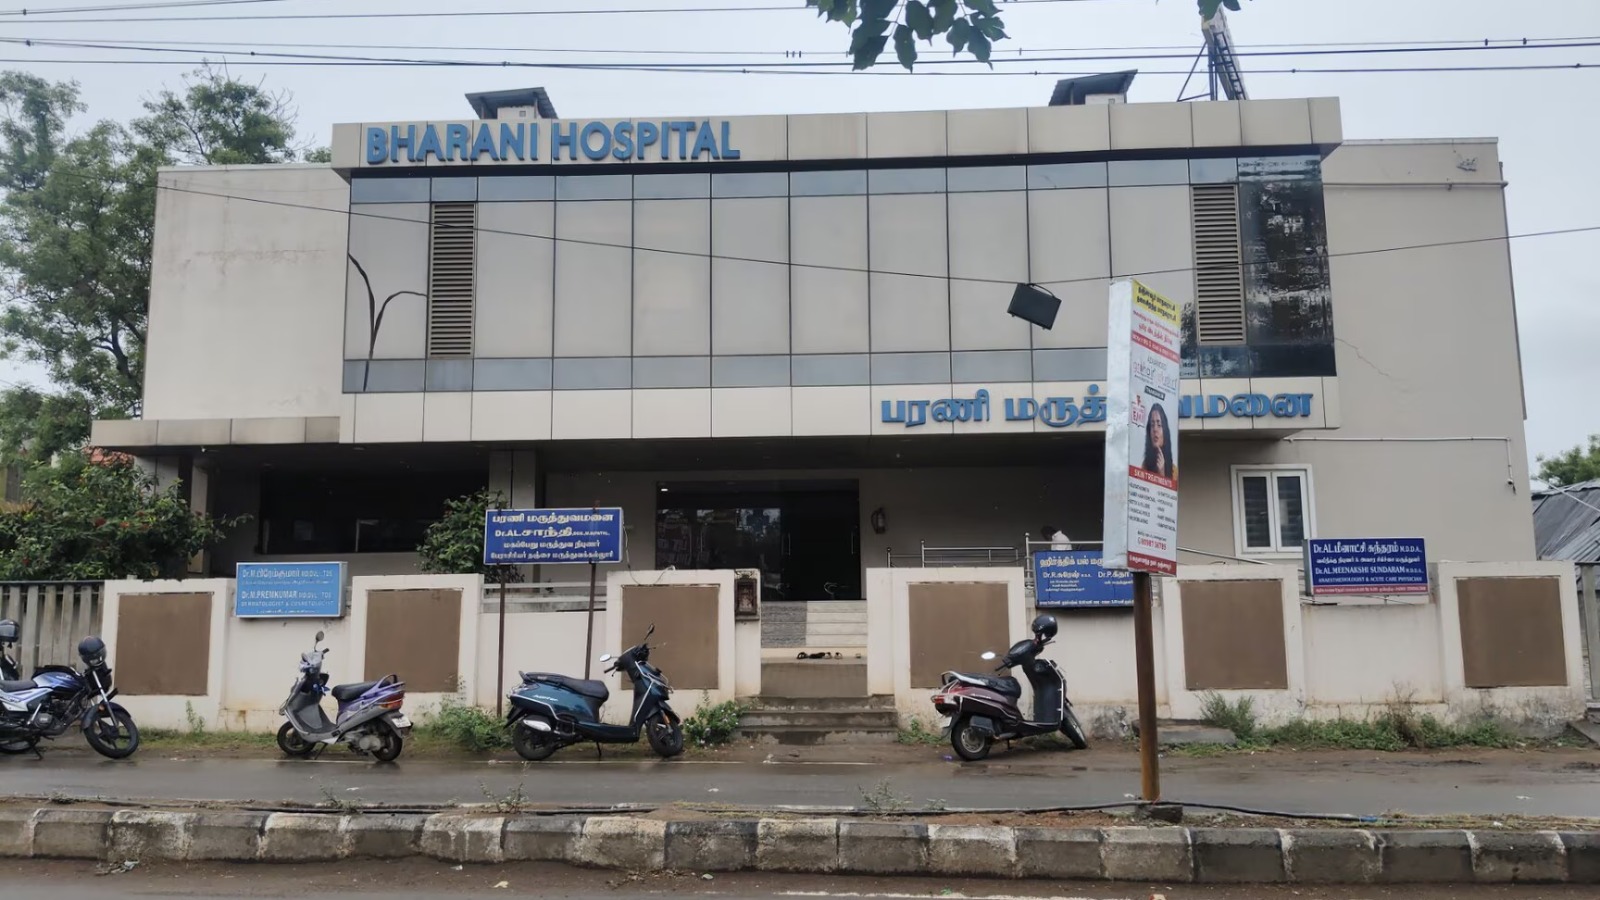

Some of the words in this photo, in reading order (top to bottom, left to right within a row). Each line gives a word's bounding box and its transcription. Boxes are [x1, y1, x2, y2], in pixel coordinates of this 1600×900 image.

[367, 121, 539, 166] BHARANI
[552, 119, 741, 163] HOSPITAL
[881, 388, 990, 428] பரணி
[492, 513, 524, 524] பரணி
[527, 512, 613, 524] மருத்துவமனை
[540, 540, 573, 549] மருத்துவ
[575, 540, 600, 549] நிபுணர்
[1368, 541, 1399, 555] சுந்தரம்
[1077, 555, 1088, 565] பல்
[1370, 566, 1405, 574] SUNDARAM
